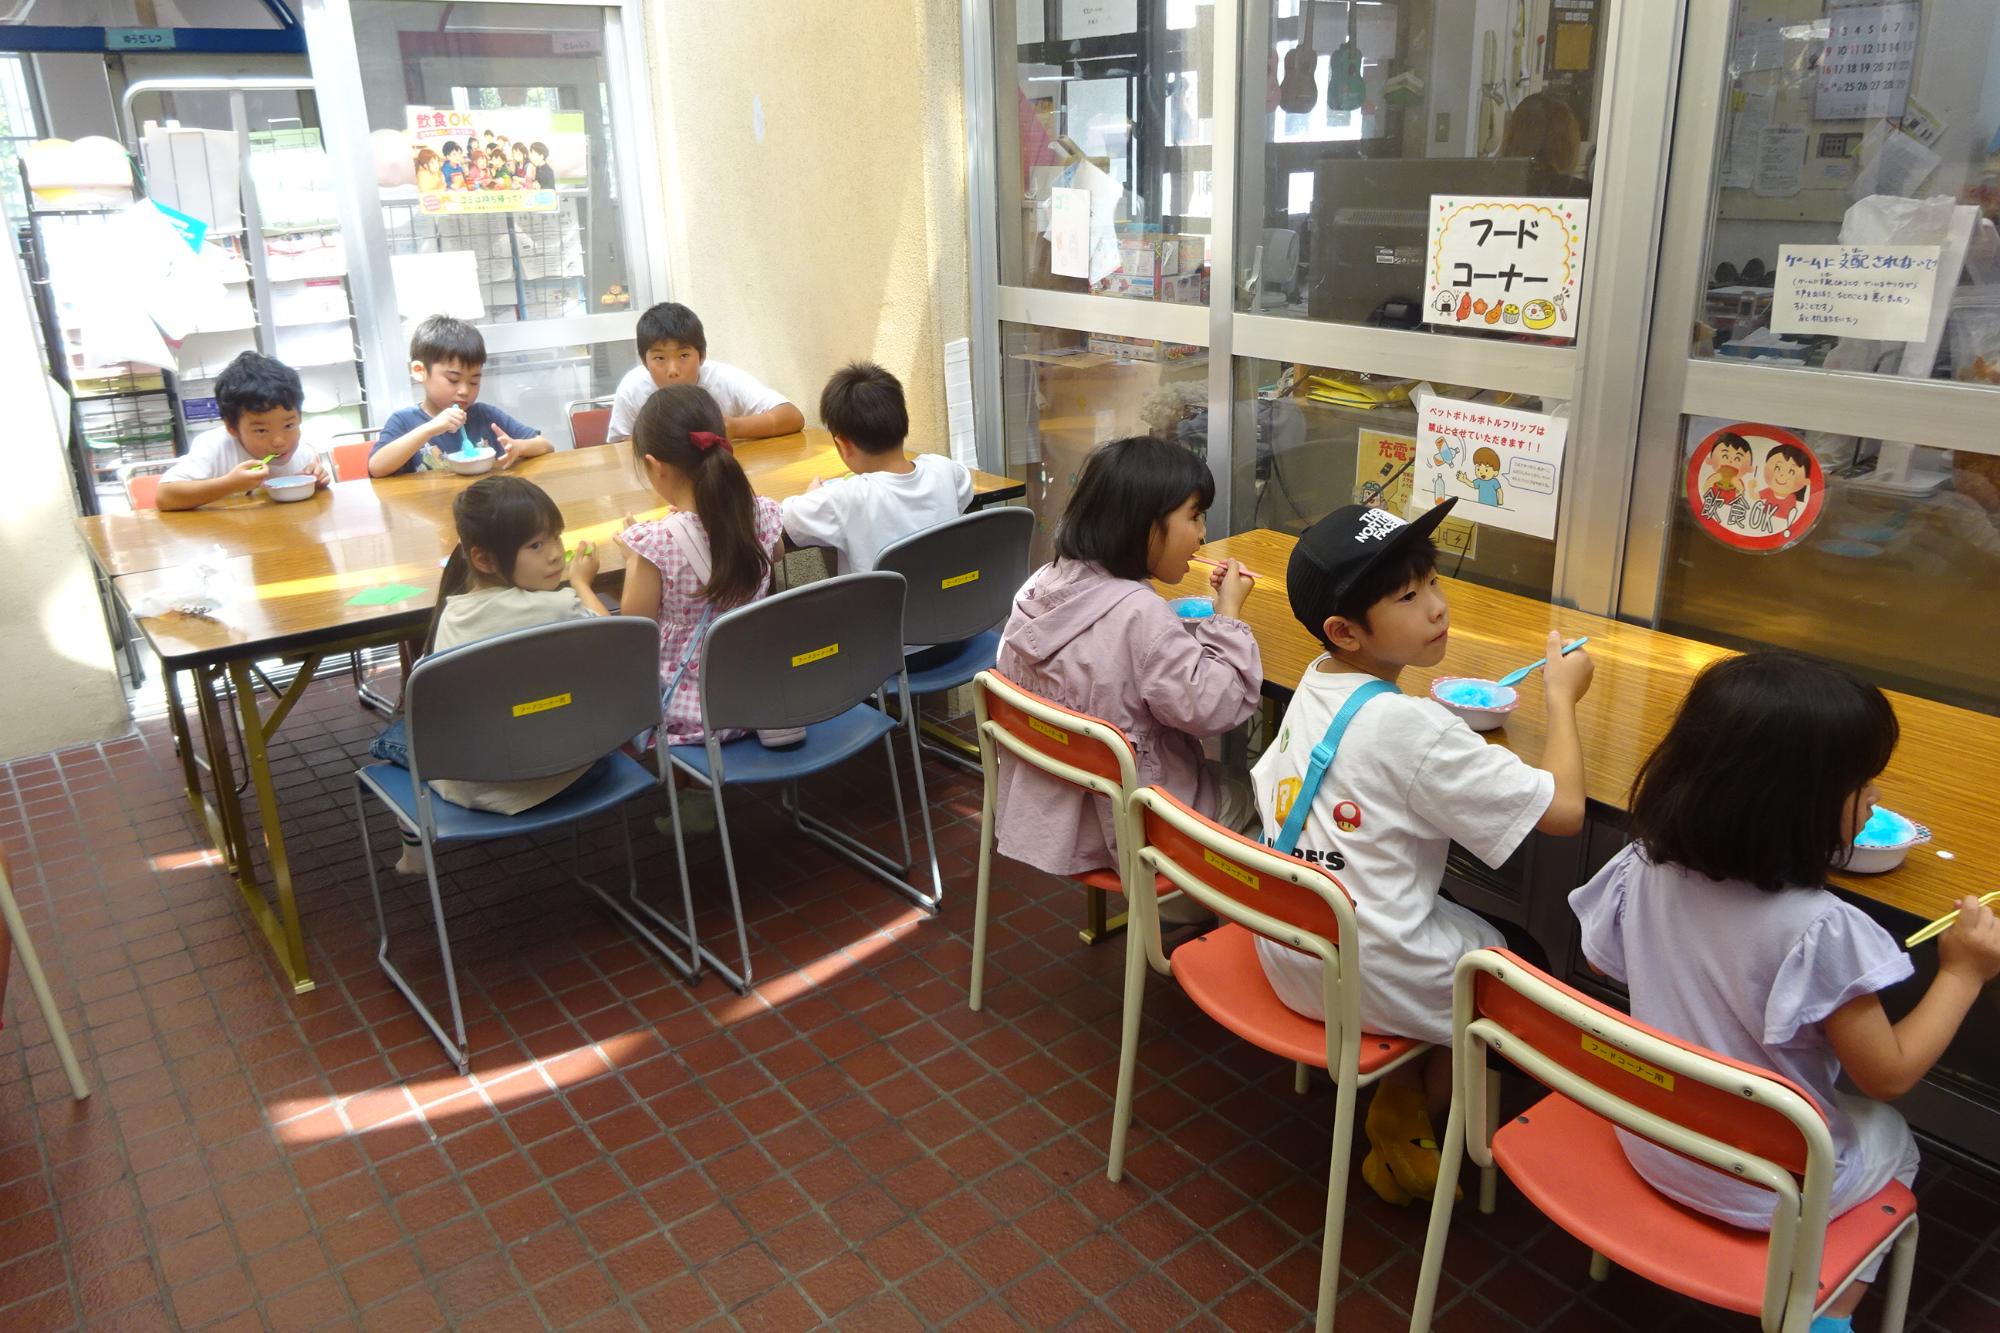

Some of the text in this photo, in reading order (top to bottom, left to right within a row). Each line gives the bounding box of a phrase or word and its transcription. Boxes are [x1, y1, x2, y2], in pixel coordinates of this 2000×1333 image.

[1841, 27, 1848, 36] 3
[1854, 26, 1861, 34] 4
[1868, 25, 1874, 34] 5
[1881, 24, 1887, 32] 6
[1894, 23, 1900, 32] 7
[1825, 47, 1832, 56] 9
[1838, 46, 1847, 55] 10
[1851, 45, 1859, 54] 11
[1863, 44, 1873, 54] 12
[1876, 43, 1886, 53] 13
[1889, 43, 1899, 52] 14
[1823, 66, 1831, 75] 16
[1834, 65, 1843, 74] 17
[1847, 64, 1856, 73] 18
[1860, 64, 1870, 72] 19
[1873, 63, 1883, 72] 20
[1886, 62, 1896, 71] 21
[1844, 82, 1854, 91] 25
[1857, 81, 1867, 91] 26
[1871, 80, 1880, 90] 27
[416, 112, 472, 128] 飲食OK
[1470, 219, 1539, 249] フード
[1452, 262, 1548, 292] コーナー
[1429, 406, 1545, 436] ペットボトルボトルフリップは
[1354, 514, 1391, 543] NORTH
[1372, 520, 1402, 541] FACE
[1591, 1043, 1664, 1084] フードコーナー用
